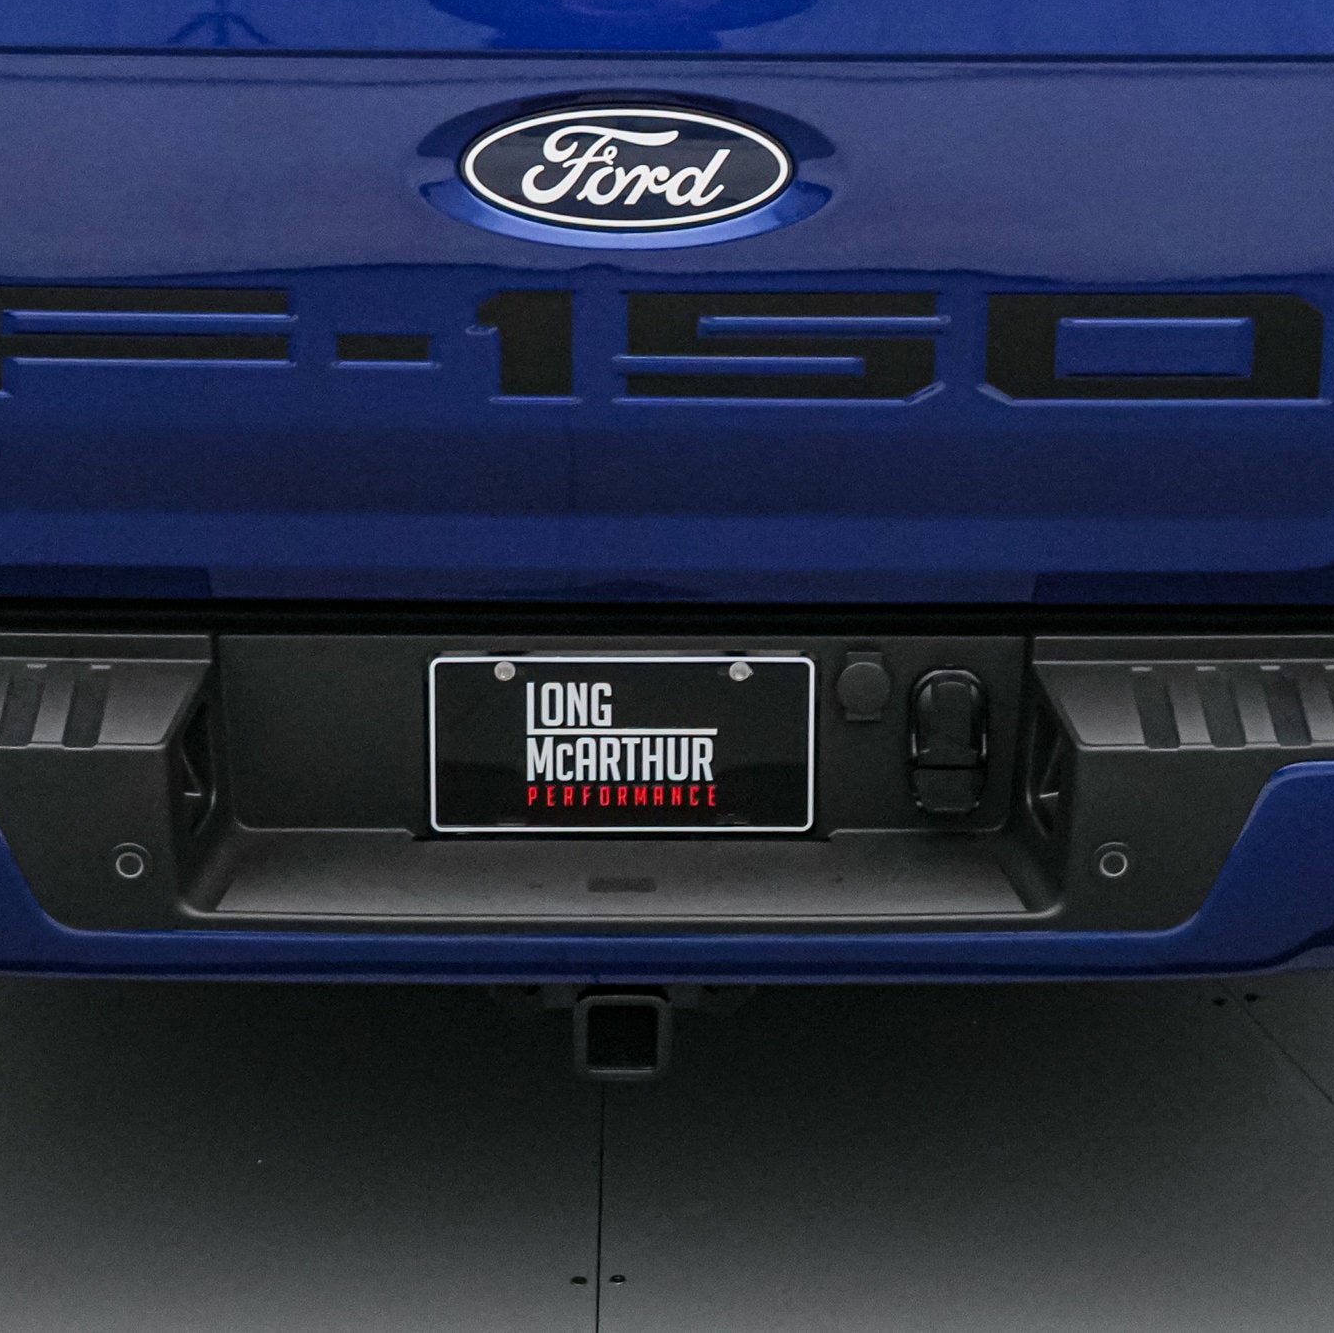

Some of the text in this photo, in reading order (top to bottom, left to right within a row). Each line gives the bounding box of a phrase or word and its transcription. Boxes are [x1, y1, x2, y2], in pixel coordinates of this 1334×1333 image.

[521, 125, 731, 206] Ford
[526, 737, 714, 782] McARTHUR
[527, 785, 716, 807] PERFORMANCE
